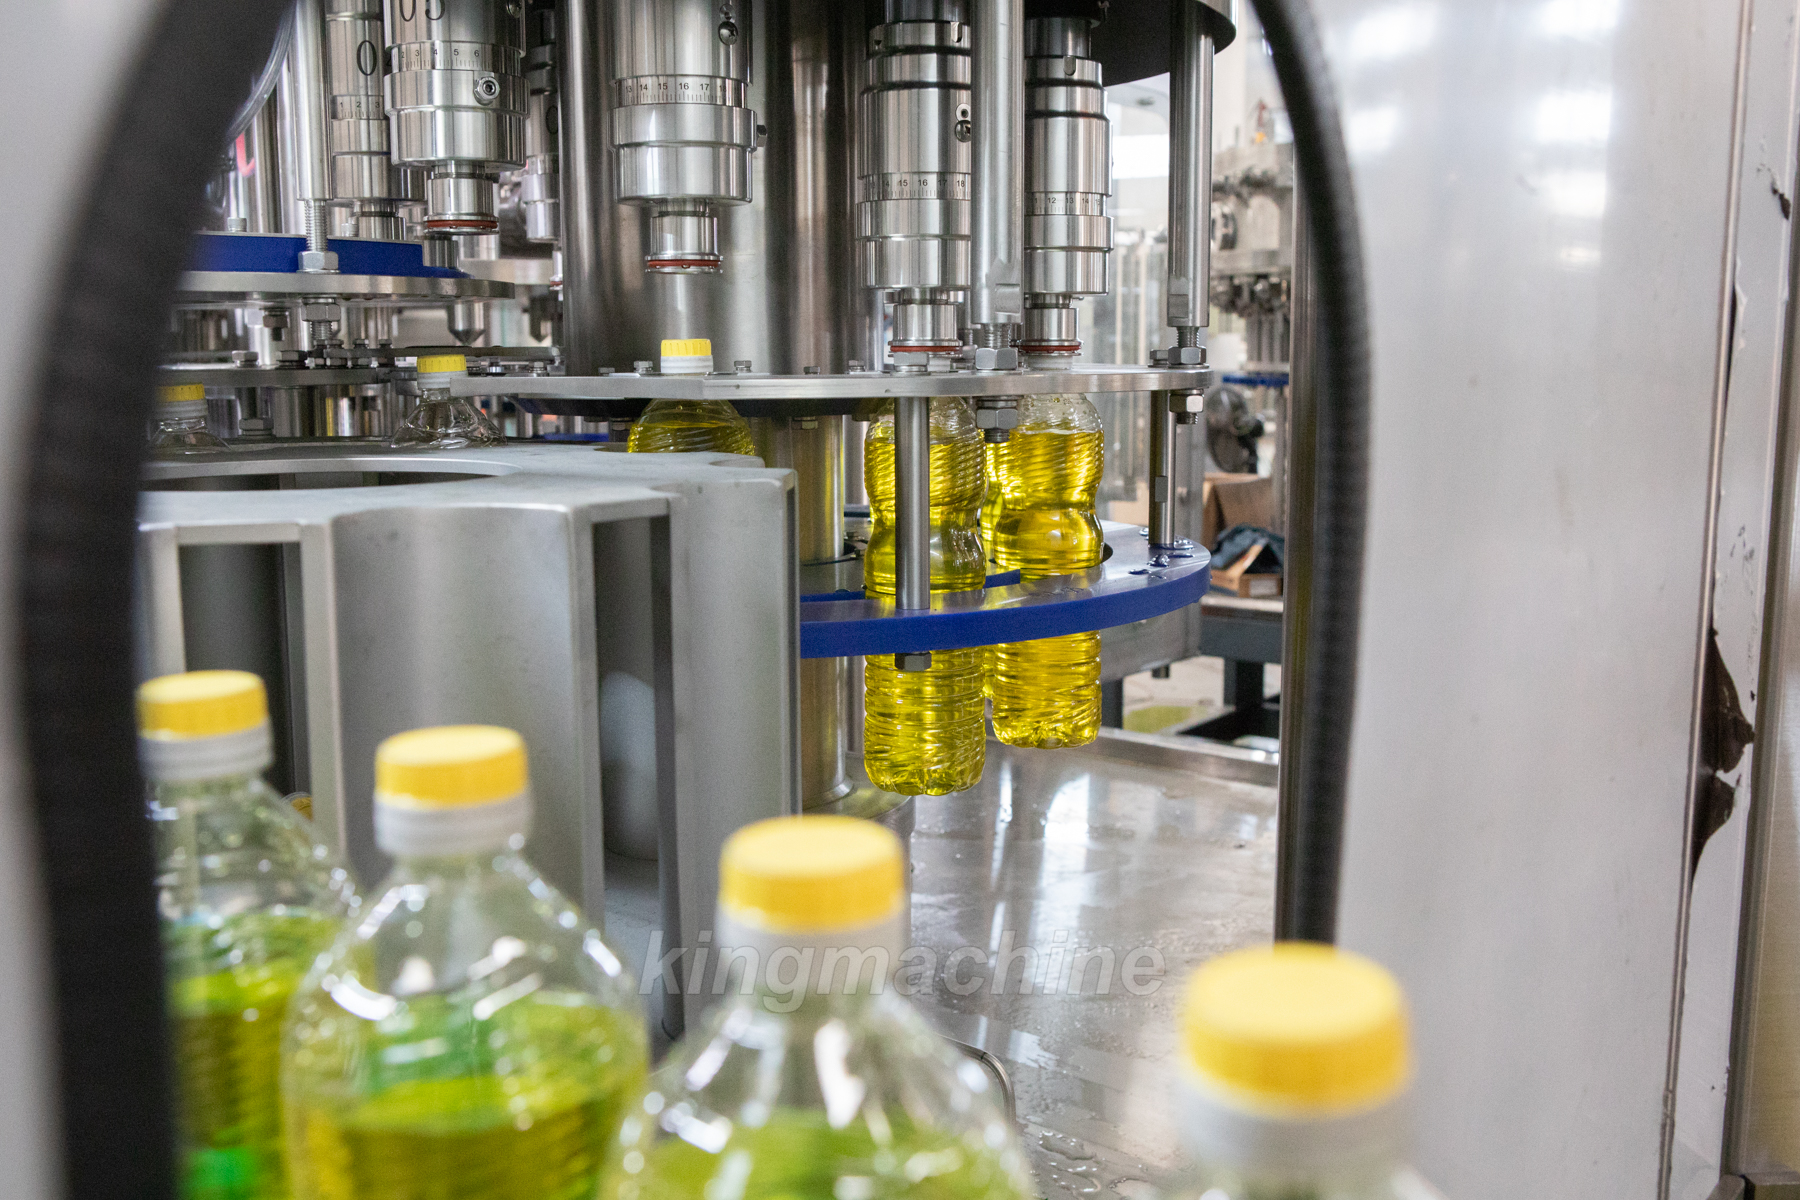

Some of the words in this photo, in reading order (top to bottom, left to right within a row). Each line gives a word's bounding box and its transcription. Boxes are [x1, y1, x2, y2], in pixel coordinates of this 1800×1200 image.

[414, 49, 420, 57] 3
[433, 48, 438, 56] 4
[453, 48, 460, 56] 5
[473, 49, 480, 57] 6
[625, 85, 633, 93] 13
[658, 82, 668, 90] 15
[679, 82, 690, 90] 16
[700, 83, 710, 91] 17
[374, 101, 380, 109] 3
[918, 179, 928, 187] 16
[956, 180, 966, 188] 18
